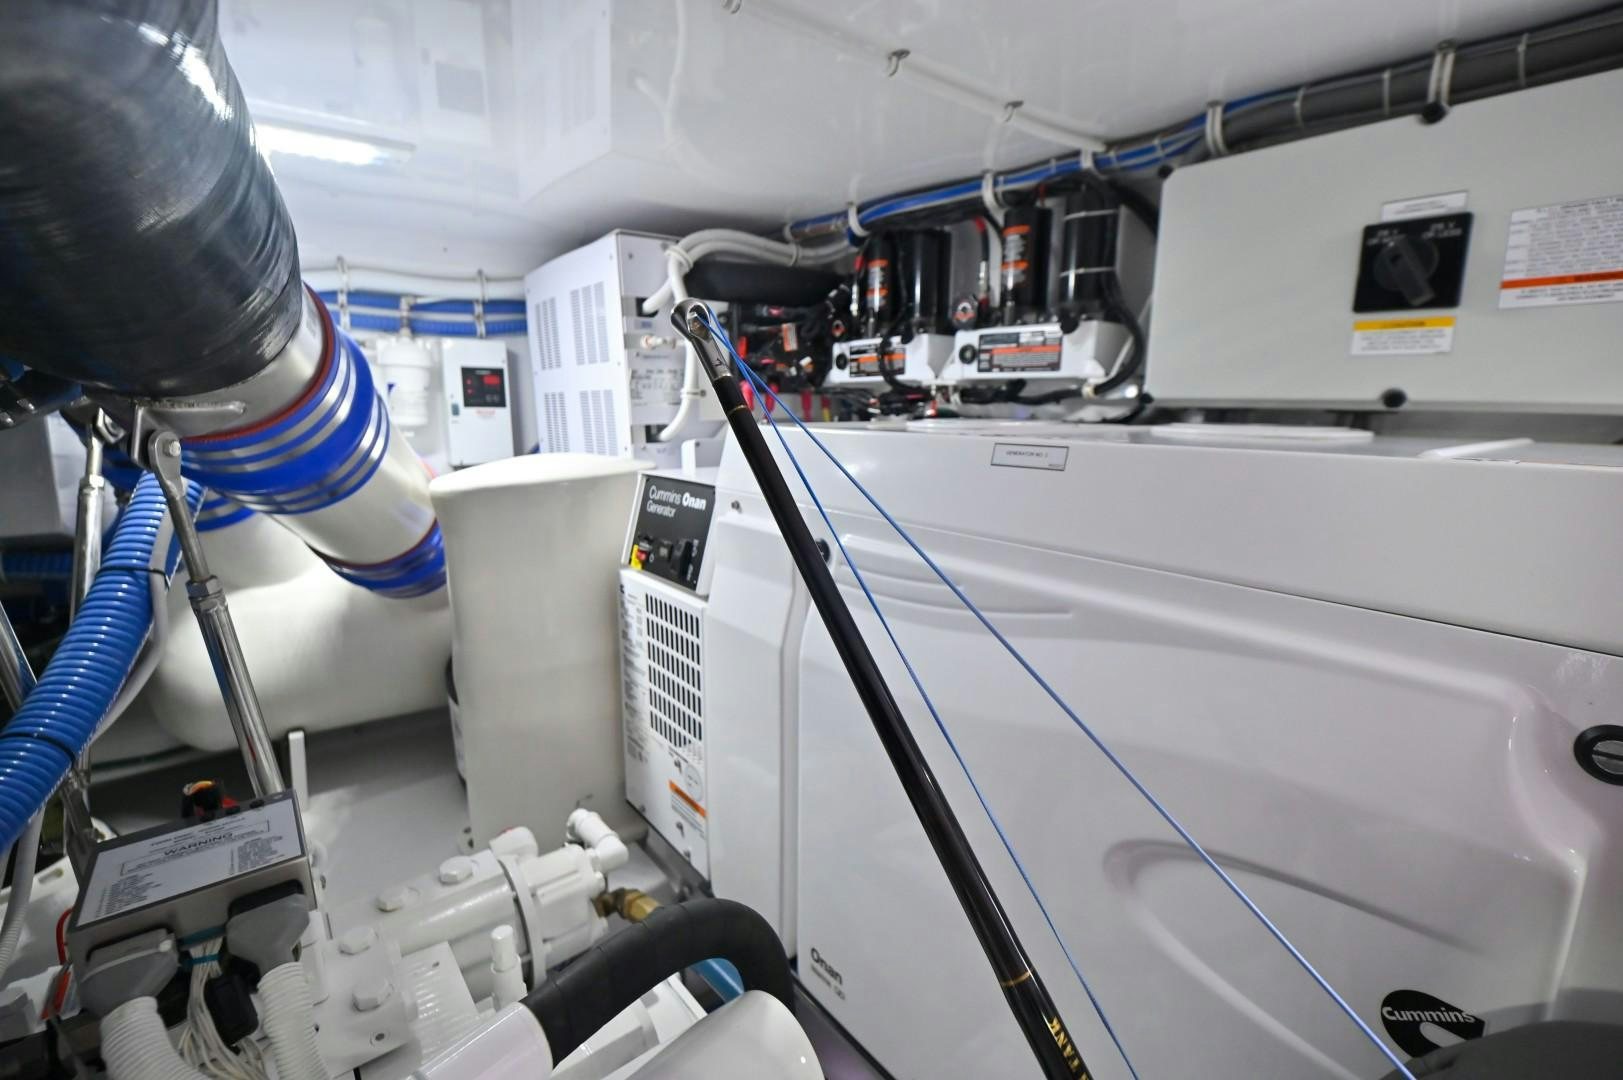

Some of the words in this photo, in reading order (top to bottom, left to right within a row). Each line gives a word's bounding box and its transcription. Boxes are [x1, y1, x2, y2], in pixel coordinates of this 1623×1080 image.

[646, 499, 676, 518] Generator
[649, 485, 682, 505] Cummins
[682, 492, 706, 511] Onan
[164, 832, 233, 856] WARNING
[811, 947, 843, 986] Onan
[1381, 1006, 1476, 1024] Cummins
